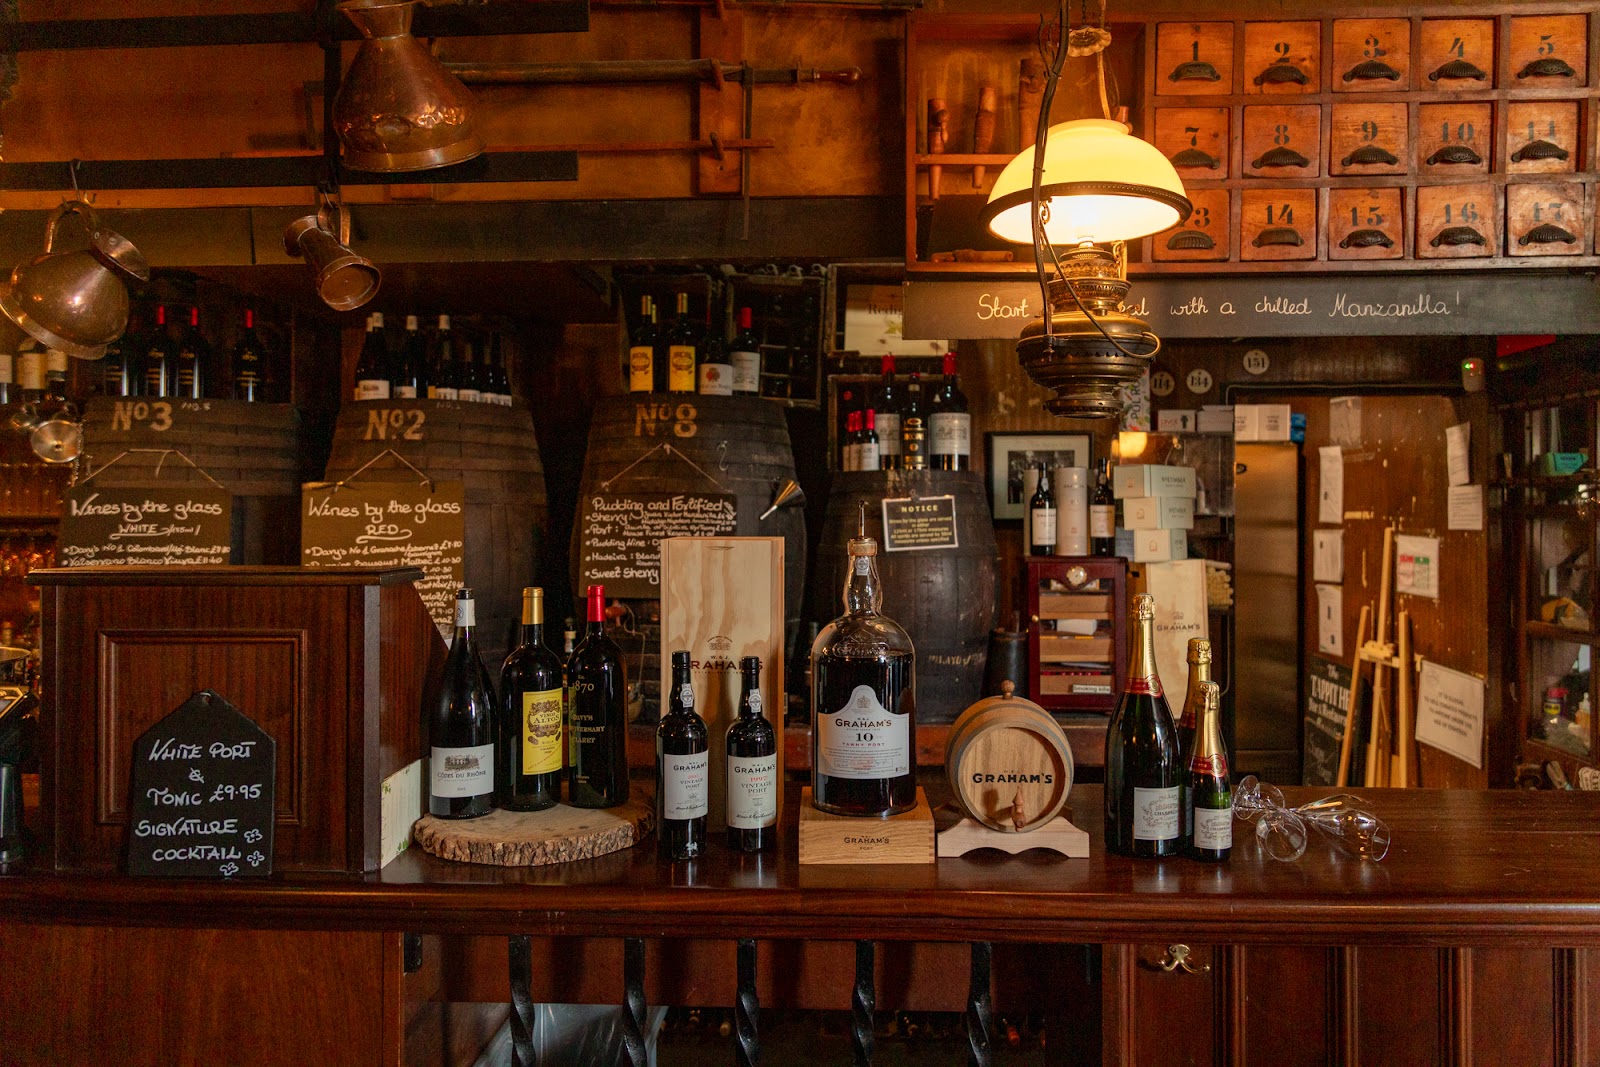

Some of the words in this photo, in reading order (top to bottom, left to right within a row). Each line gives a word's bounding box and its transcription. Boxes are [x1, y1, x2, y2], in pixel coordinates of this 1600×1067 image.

[1191, 41, 1199, 61] 1
[1274, 42, 1290, 63] 2
[1364, 36, 1380, 58] 3
[1450, 37, 1465, 58] 4
[1538, 35, 1554, 55] 5
[1185, 127, 1200, 146] 7
[1274, 124, 1290, 145] 8
[1361, 120, 1378, 141] 9
[1440, 122, 1474, 143] 10
[1526, 120, 1557, 142] 11
[1265, 204, 1294, 225] 14
[1350, 206, 1382, 226] 15
[1443, 202, 1478, 224] 16
[1532, 202, 1563, 222] 17
[976, 293, 1030, 320] Start
[1170, 296, 1209, 316] with
[1220, 301, 1236, 315] a
[1254, 296, 1312, 315] chilled
[1328, 291, 1461, 318] Manzanilla!
[71, 493, 120, 516] Wines
[122, 500, 143, 522] by
[142, 500, 170, 513] the
[174, 500, 222, 520] glass
[308, 496, 360, 517] Wines
[364, 503, 384, 524] by
[388, 500, 412, 514] the
[414, 498, 461, 524] glass
[592, 497, 644, 520] Pudding
[647, 499, 670, 511] and
[672, 495, 723, 513] Fortified
[901, 504, 938, 512] NOTICE
[118, 524, 158, 535] WHITE
[365, 524, 399, 536] RED
[310, 546, 348, 560] Davy's
[590, 538, 627, 550] Pudding
[401, 558, 434, 566] Malbec
[591, 552, 627, 562] Madeira
[590, 566, 622, 580] Sweet
[622, 568, 660, 584] Sherry
[1156, 623, 1200, 632] GRAHAM'S
[836, 718, 892, 728] GRAHAM'S
[856, 732, 874, 742] 10
[149, 738, 202, 761] WHITE
[209, 742, 256, 761] PORT
[188, 768, 204, 784] &
[734, 764, 776, 774] GRAHAM'S
[972, 773, 1052, 784] GRAHAM'S
[147, 787, 202, 807] TONIC
[209, 784, 262, 804] £9.95
[135, 817, 238, 836] SIGNATURE
[152, 846, 242, 862] COCKTAIL
